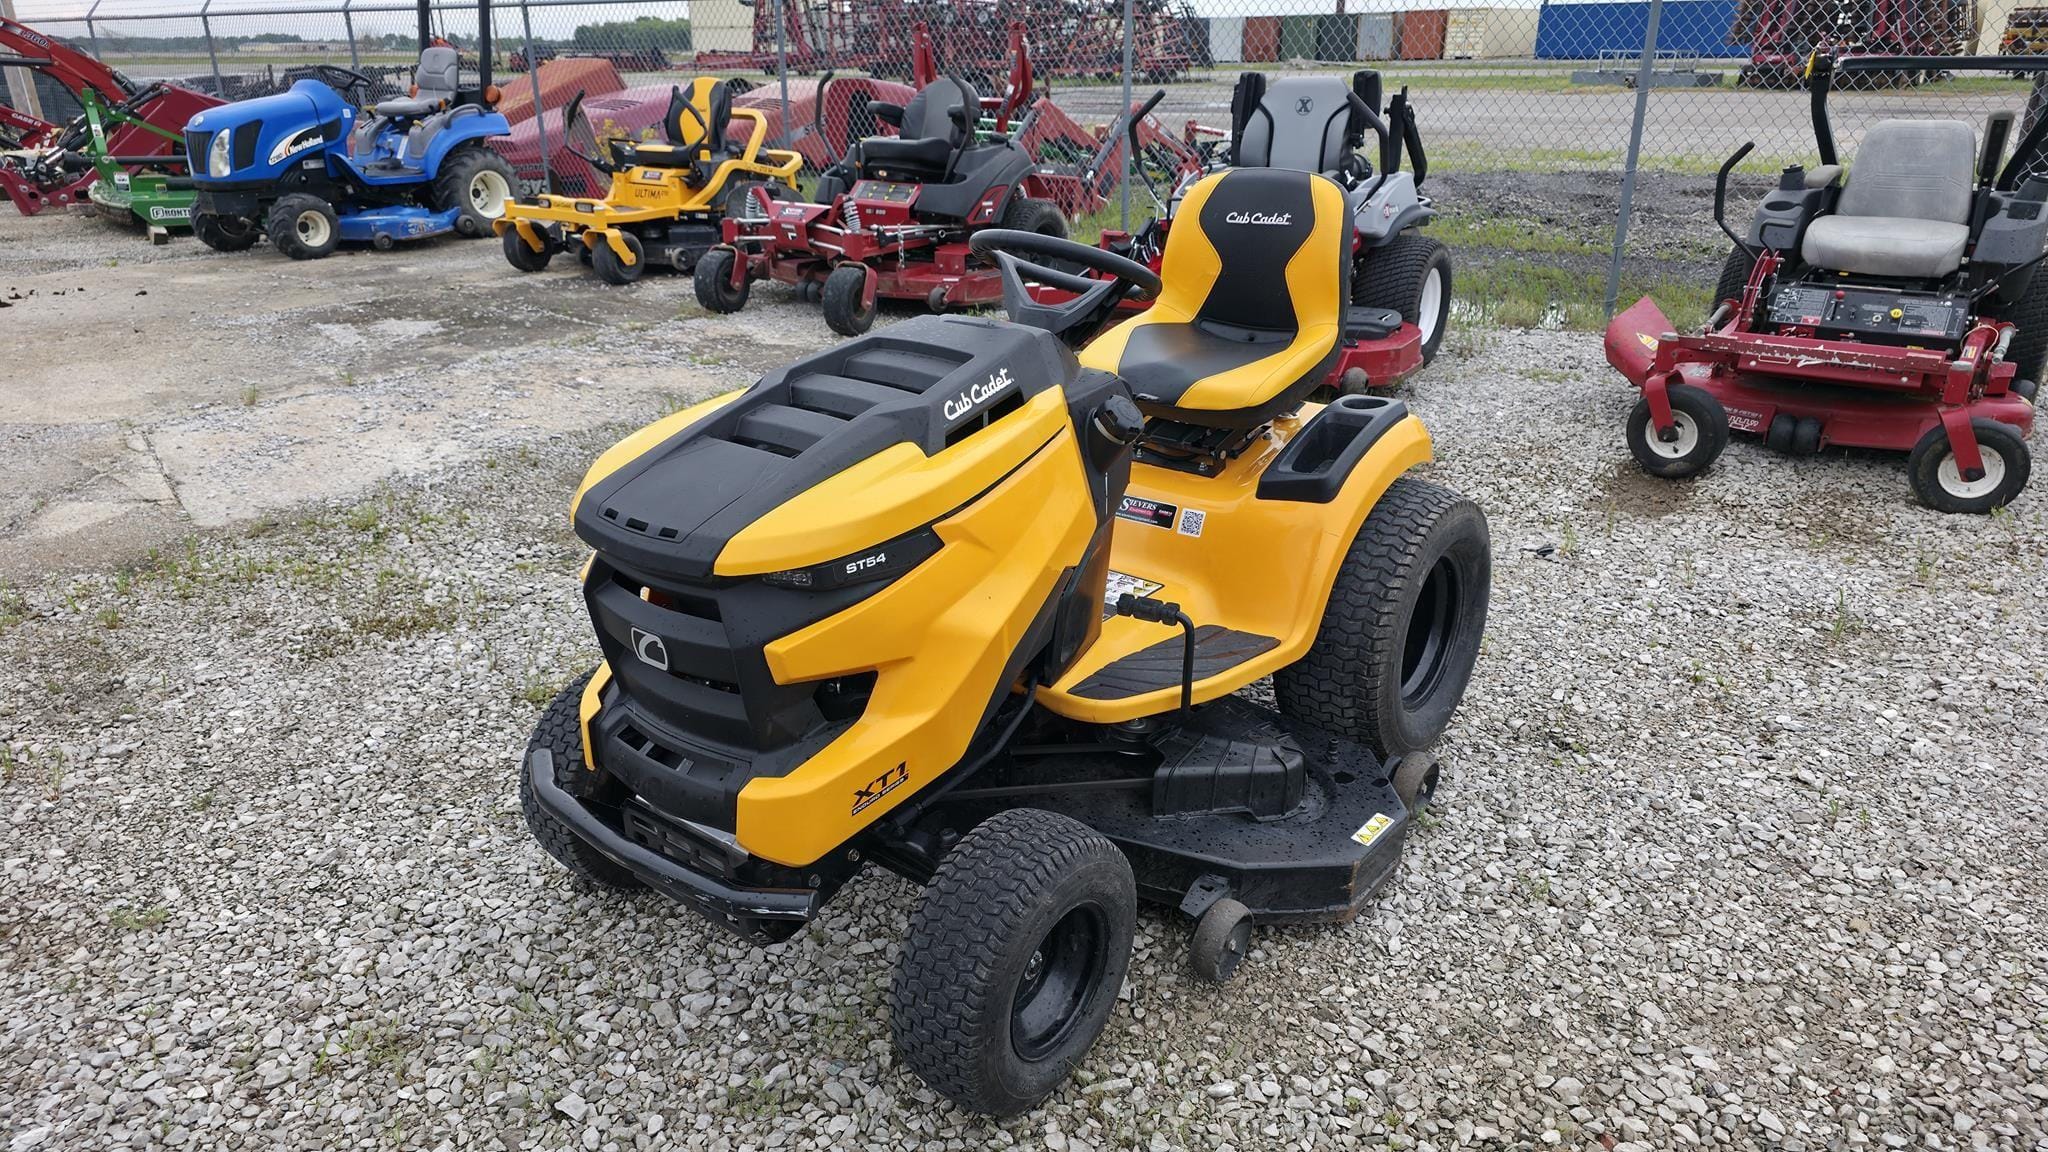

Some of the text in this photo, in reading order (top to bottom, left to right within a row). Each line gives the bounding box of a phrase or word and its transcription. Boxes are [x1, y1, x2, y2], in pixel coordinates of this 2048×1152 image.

[634, 188, 661, 200] ULTIMA
[151, 206, 191, 219] FRONTI
[1226, 211, 1292, 225] Cub Cadet
[944, 367, 1012, 420] Cub Cadet
[1119, 498, 1158, 511] SIEVERS
[846, 552, 887, 574] ST54
[852, 760, 907, 808] XT1
